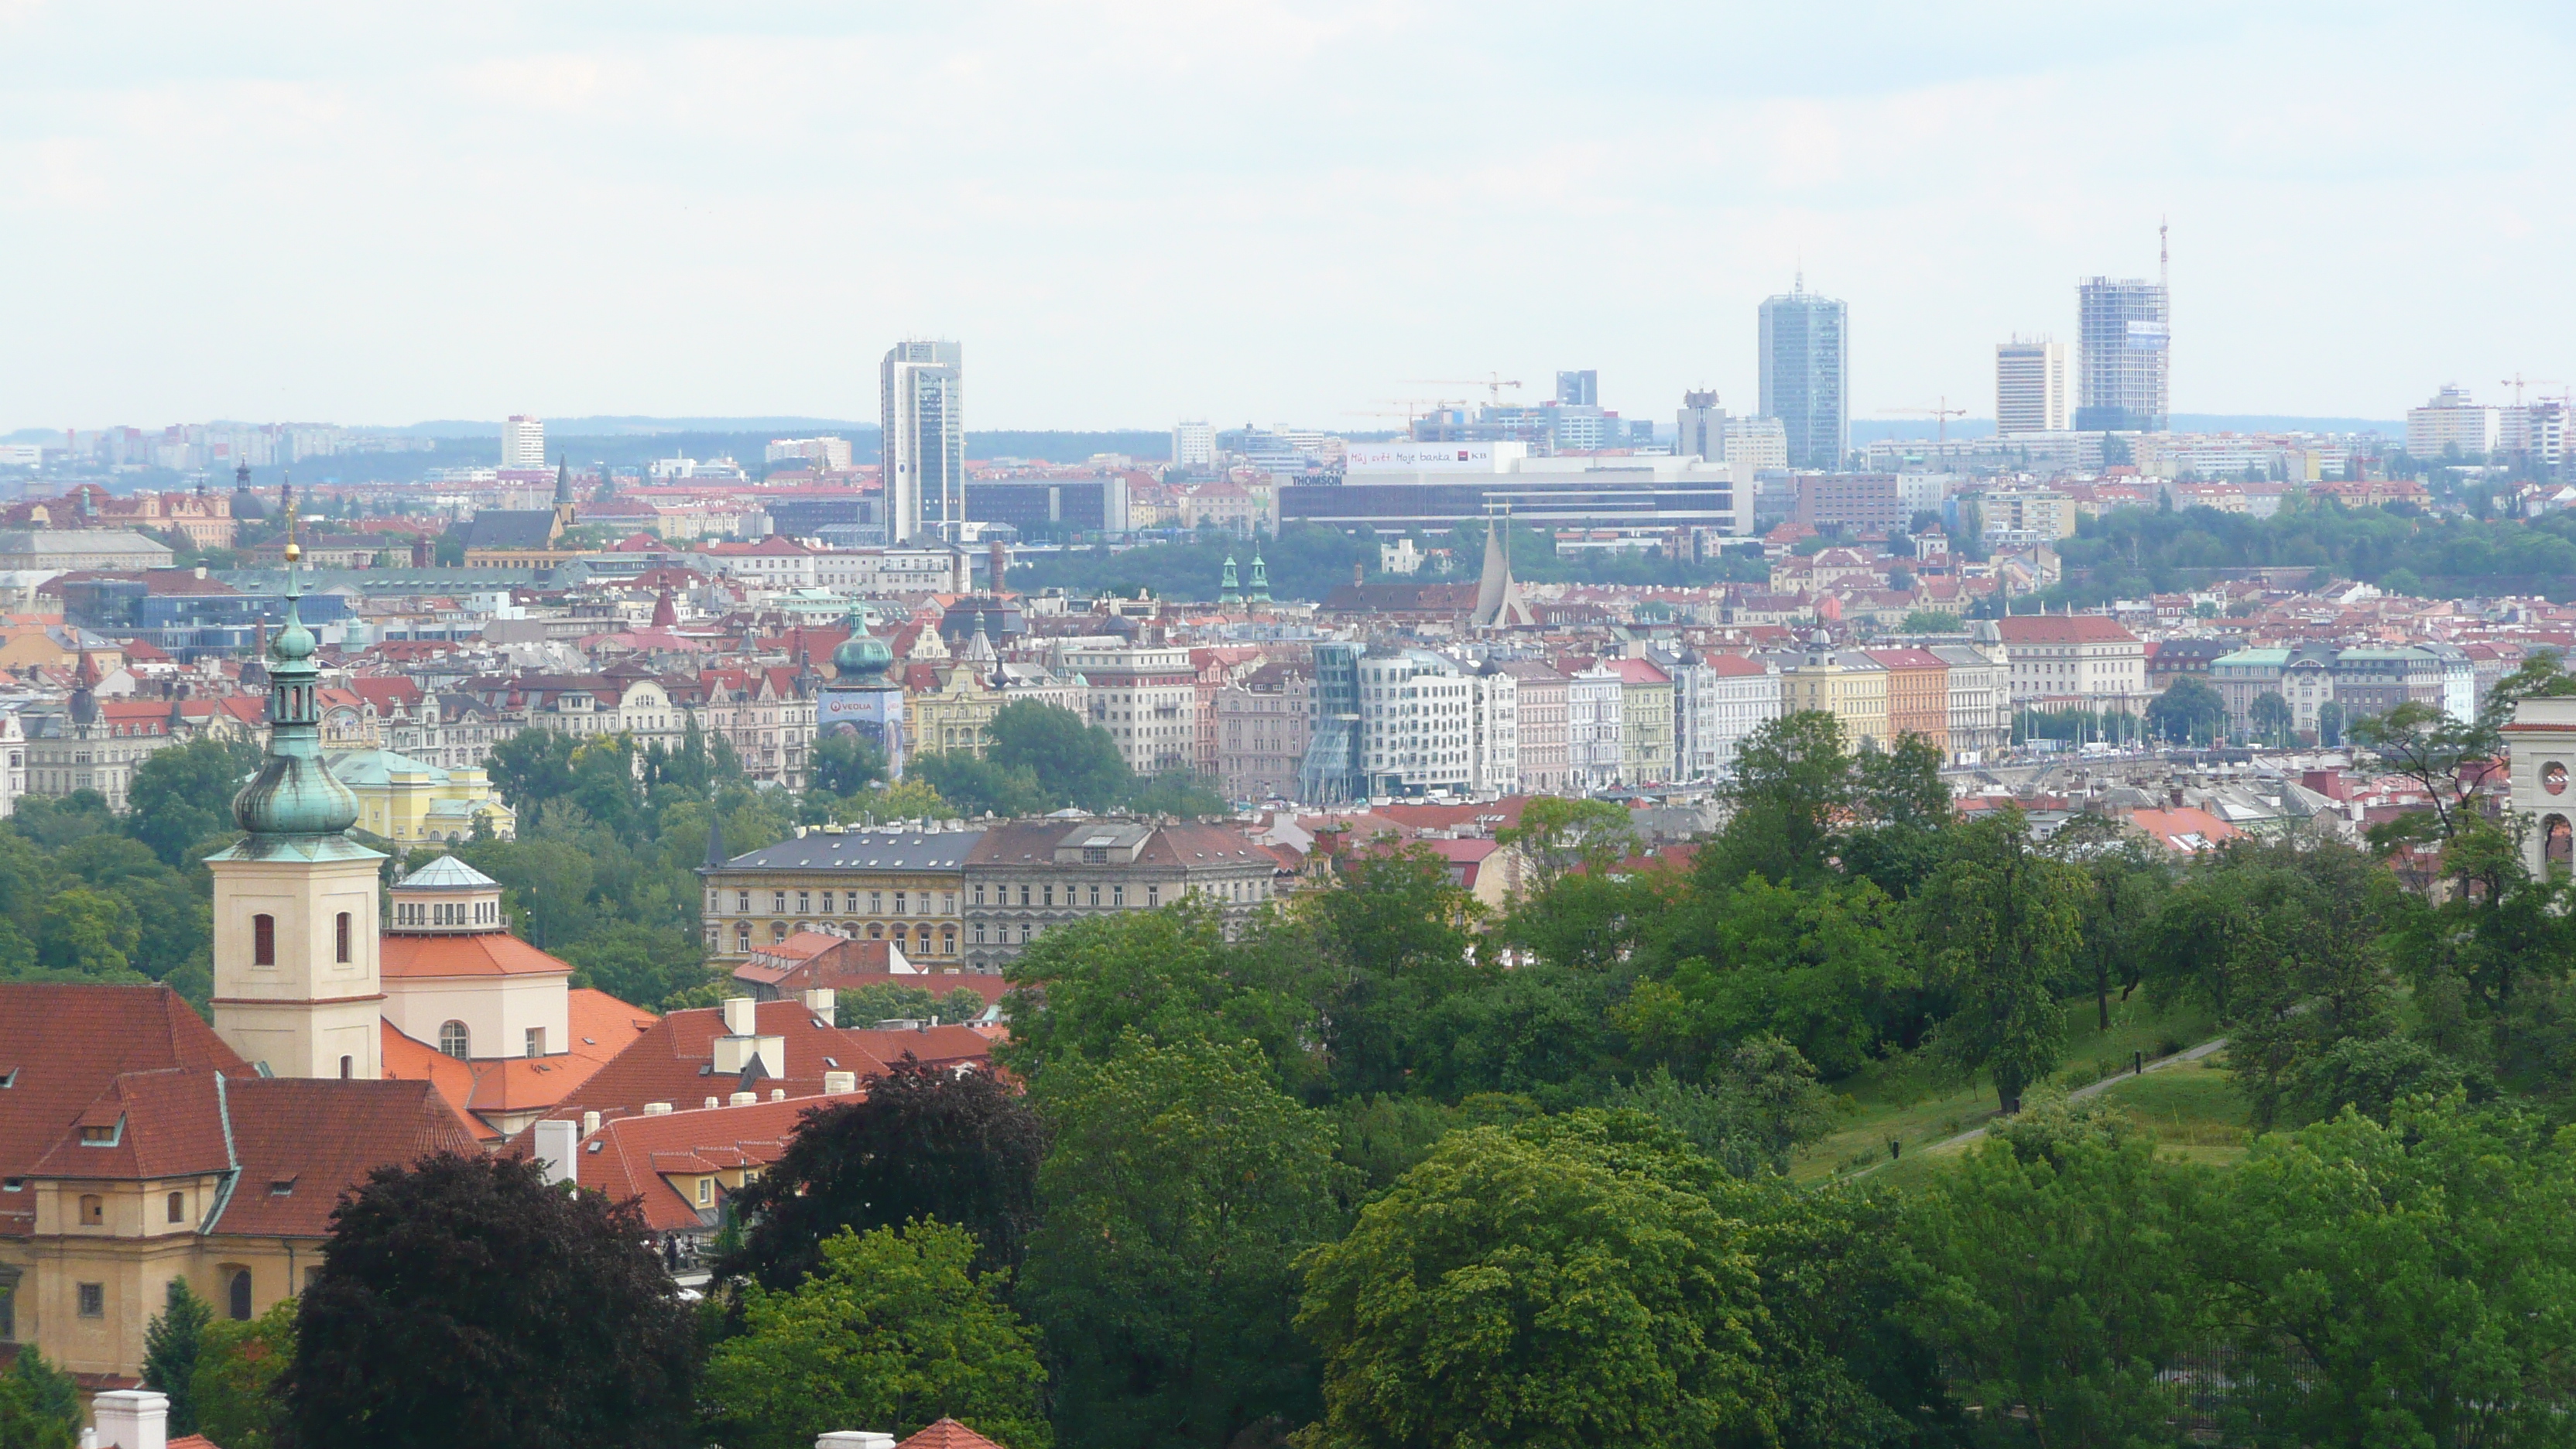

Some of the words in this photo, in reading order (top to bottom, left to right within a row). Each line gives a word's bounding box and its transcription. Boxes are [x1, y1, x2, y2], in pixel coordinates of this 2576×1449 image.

[1351, 452, 1367, 465] Můj
[1396, 452, 1416, 464] Moje
[1292, 474, 1342, 485] THOMSON
